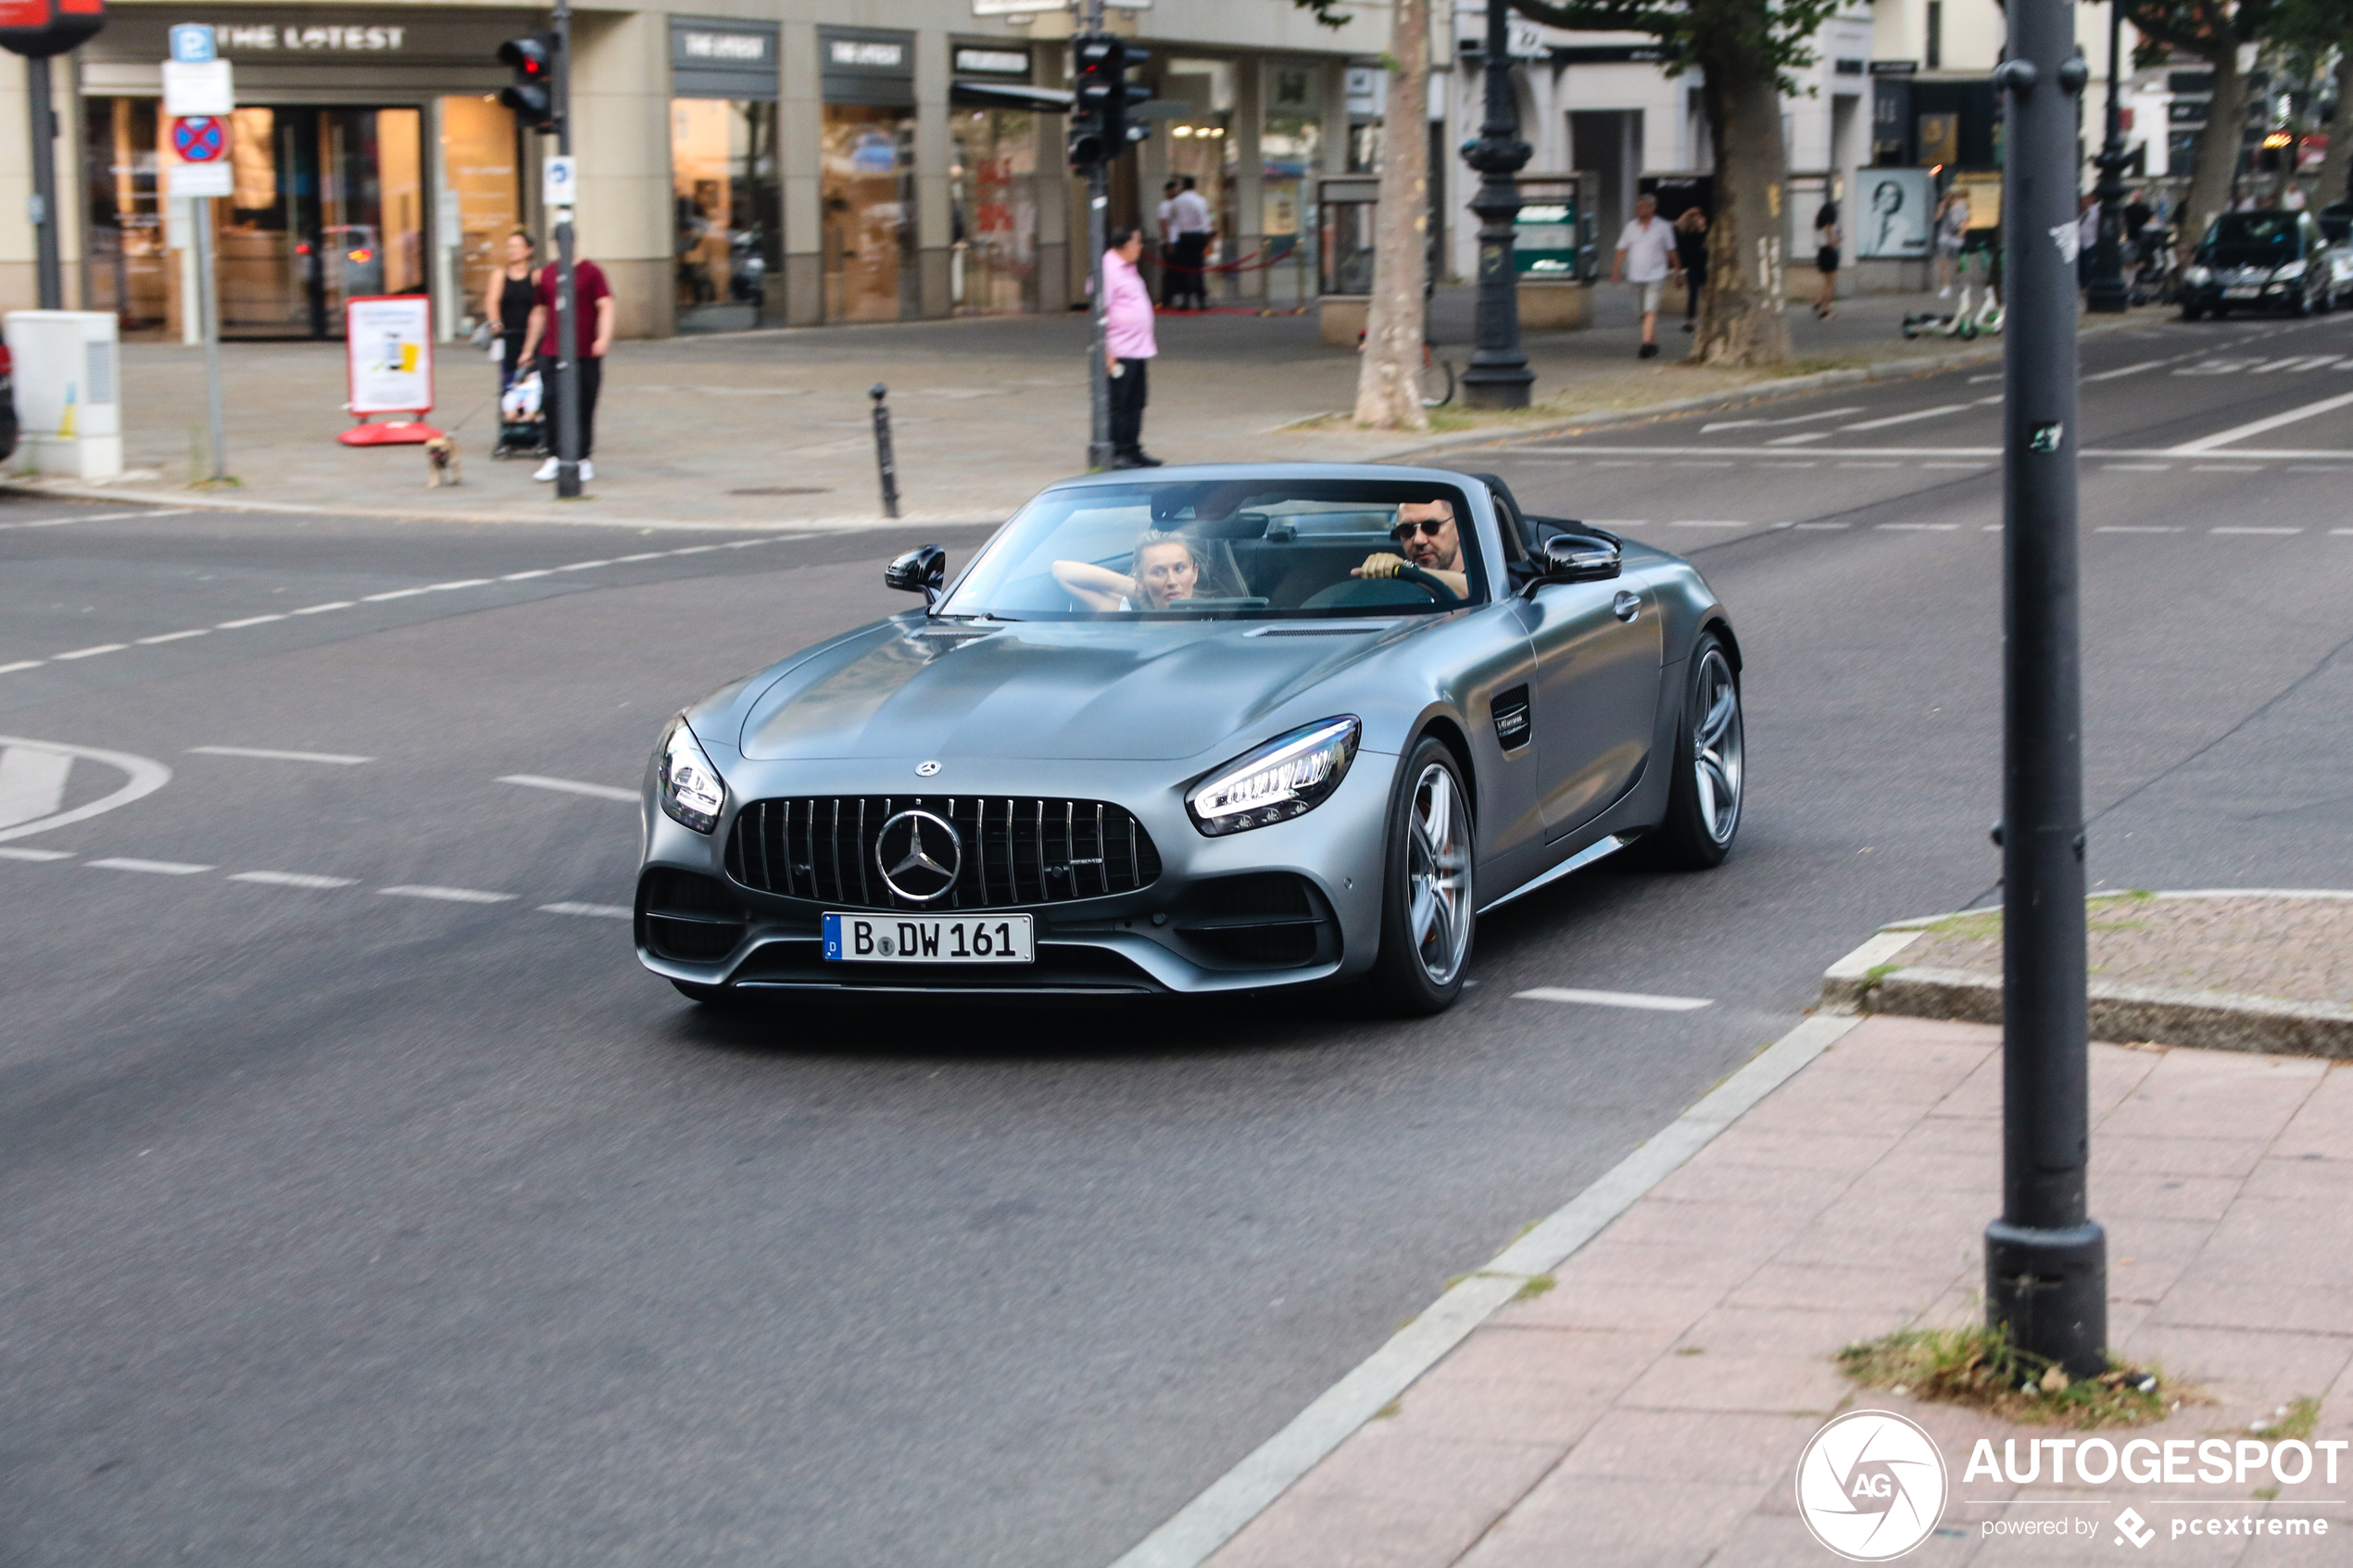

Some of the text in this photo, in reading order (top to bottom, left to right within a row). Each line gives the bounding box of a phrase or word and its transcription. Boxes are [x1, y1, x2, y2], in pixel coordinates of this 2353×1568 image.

[216, 25, 277, 48] THE
[829, 941, 837, 952] D
[854, 922, 1016, 957] B DW 161
